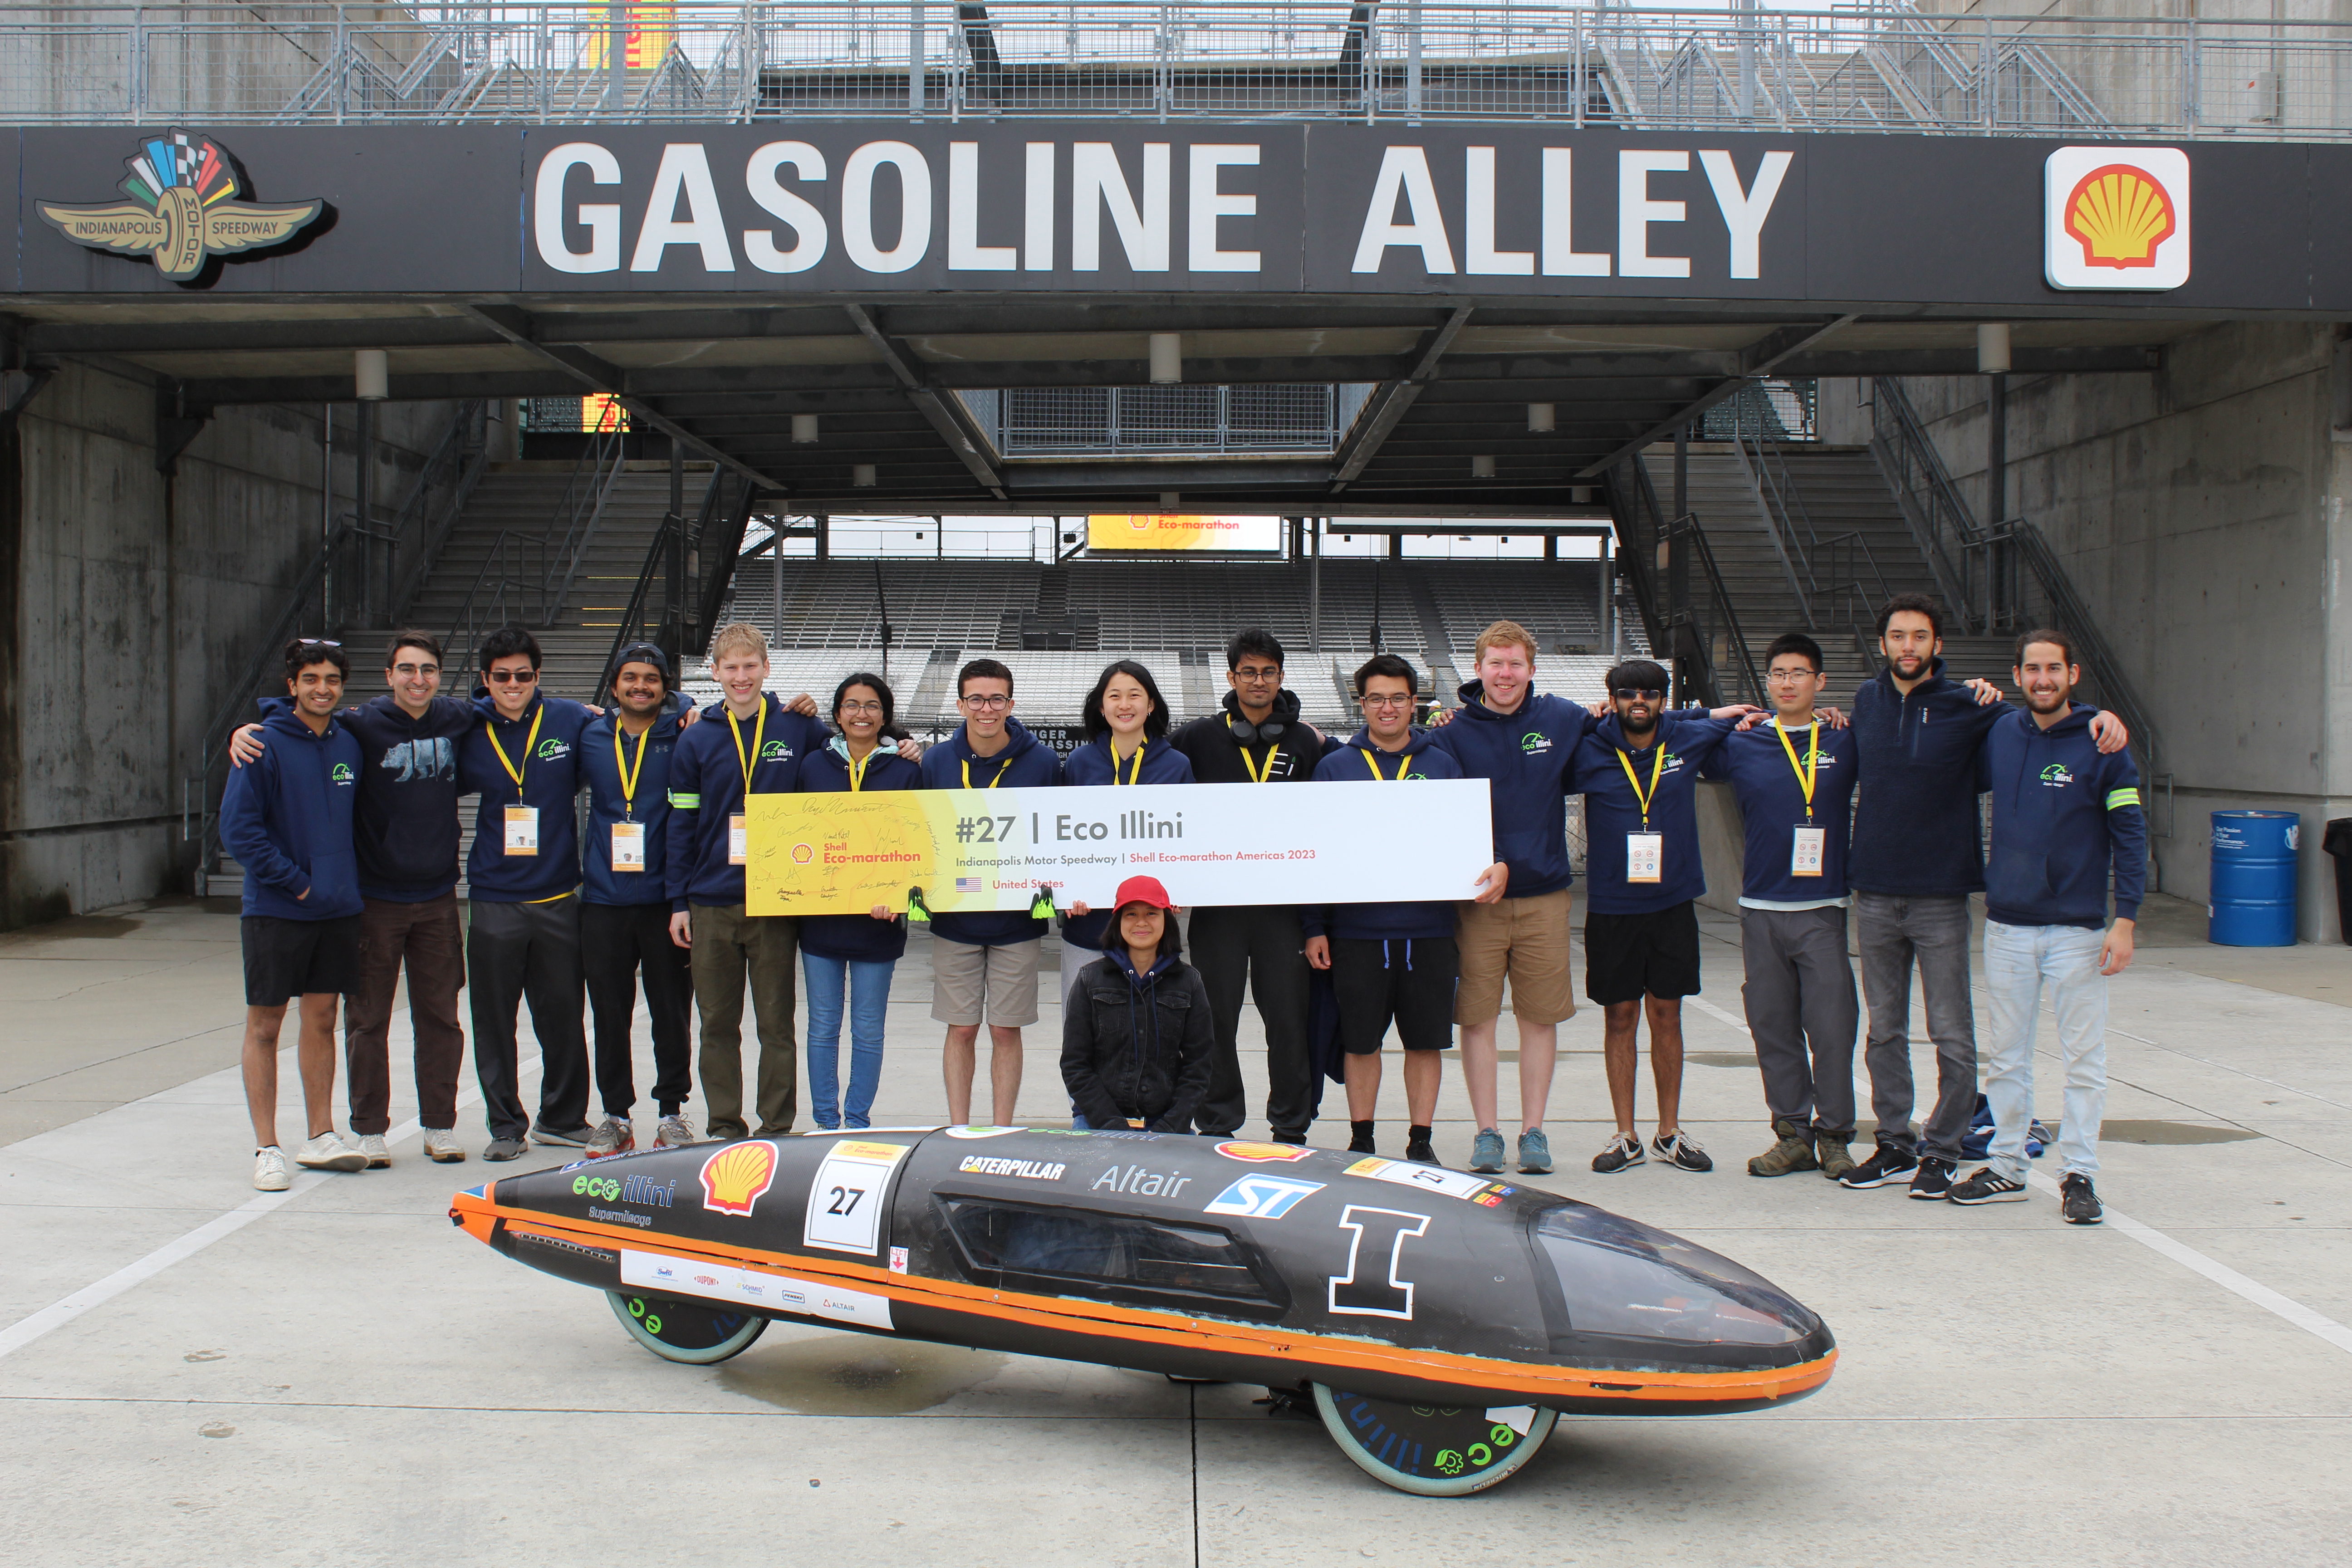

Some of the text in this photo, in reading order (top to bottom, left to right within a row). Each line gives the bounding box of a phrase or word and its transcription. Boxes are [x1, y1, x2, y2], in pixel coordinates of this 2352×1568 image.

[534, 140, 1794, 279] GASOLINE ALLEY
[75, 222, 162, 235] INDIANAPOLIS
[183, 198, 199, 265] MOTOR
[212, 222, 278, 235] SPEEDWAY
[1158, 519, 1239, 529] Eco-marathon
[538, 750, 554, 758] eco
[956, 816, 1016, 843] #27
[1056, 815, 1108, 841] Eco
[1121, 810, 1182, 839] Illini
[823, 842, 848, 851] Shell
[823, 850, 921, 864] Eco-marathon
[956, 855, 1021, 868] Indianapolis
[1024, 856, 1057, 866] Motor
[1061, 853, 1117, 867] Speedway
[1130, 852, 1155, 863] Shell
[1159, 851, 1232, 862] Eco-marathon
[1235, 850, 1284, 860] Americas
[1288, 849, 1316, 860] 2023
[992, 878, 1064, 889] United States
[959, 1156, 1066, 1181] CATERPILLAR
[1092, 1165, 1192, 1197] Altair
[1412, 1170, 1446, 1184] 27
[573, 1174, 676, 1207] eco illini
[827, 1186, 866, 1217] 27
[589, 1206, 652, 1227] Supermileage
[892, 1247, 908, 1259] LIFT
[1329, 1204, 1431, 1320] I
[697, 1276, 716, 1286] DUPONT
[742, 1284, 763, 1293] SCHMID
[832, 1302, 855, 1312] ALTAIR
